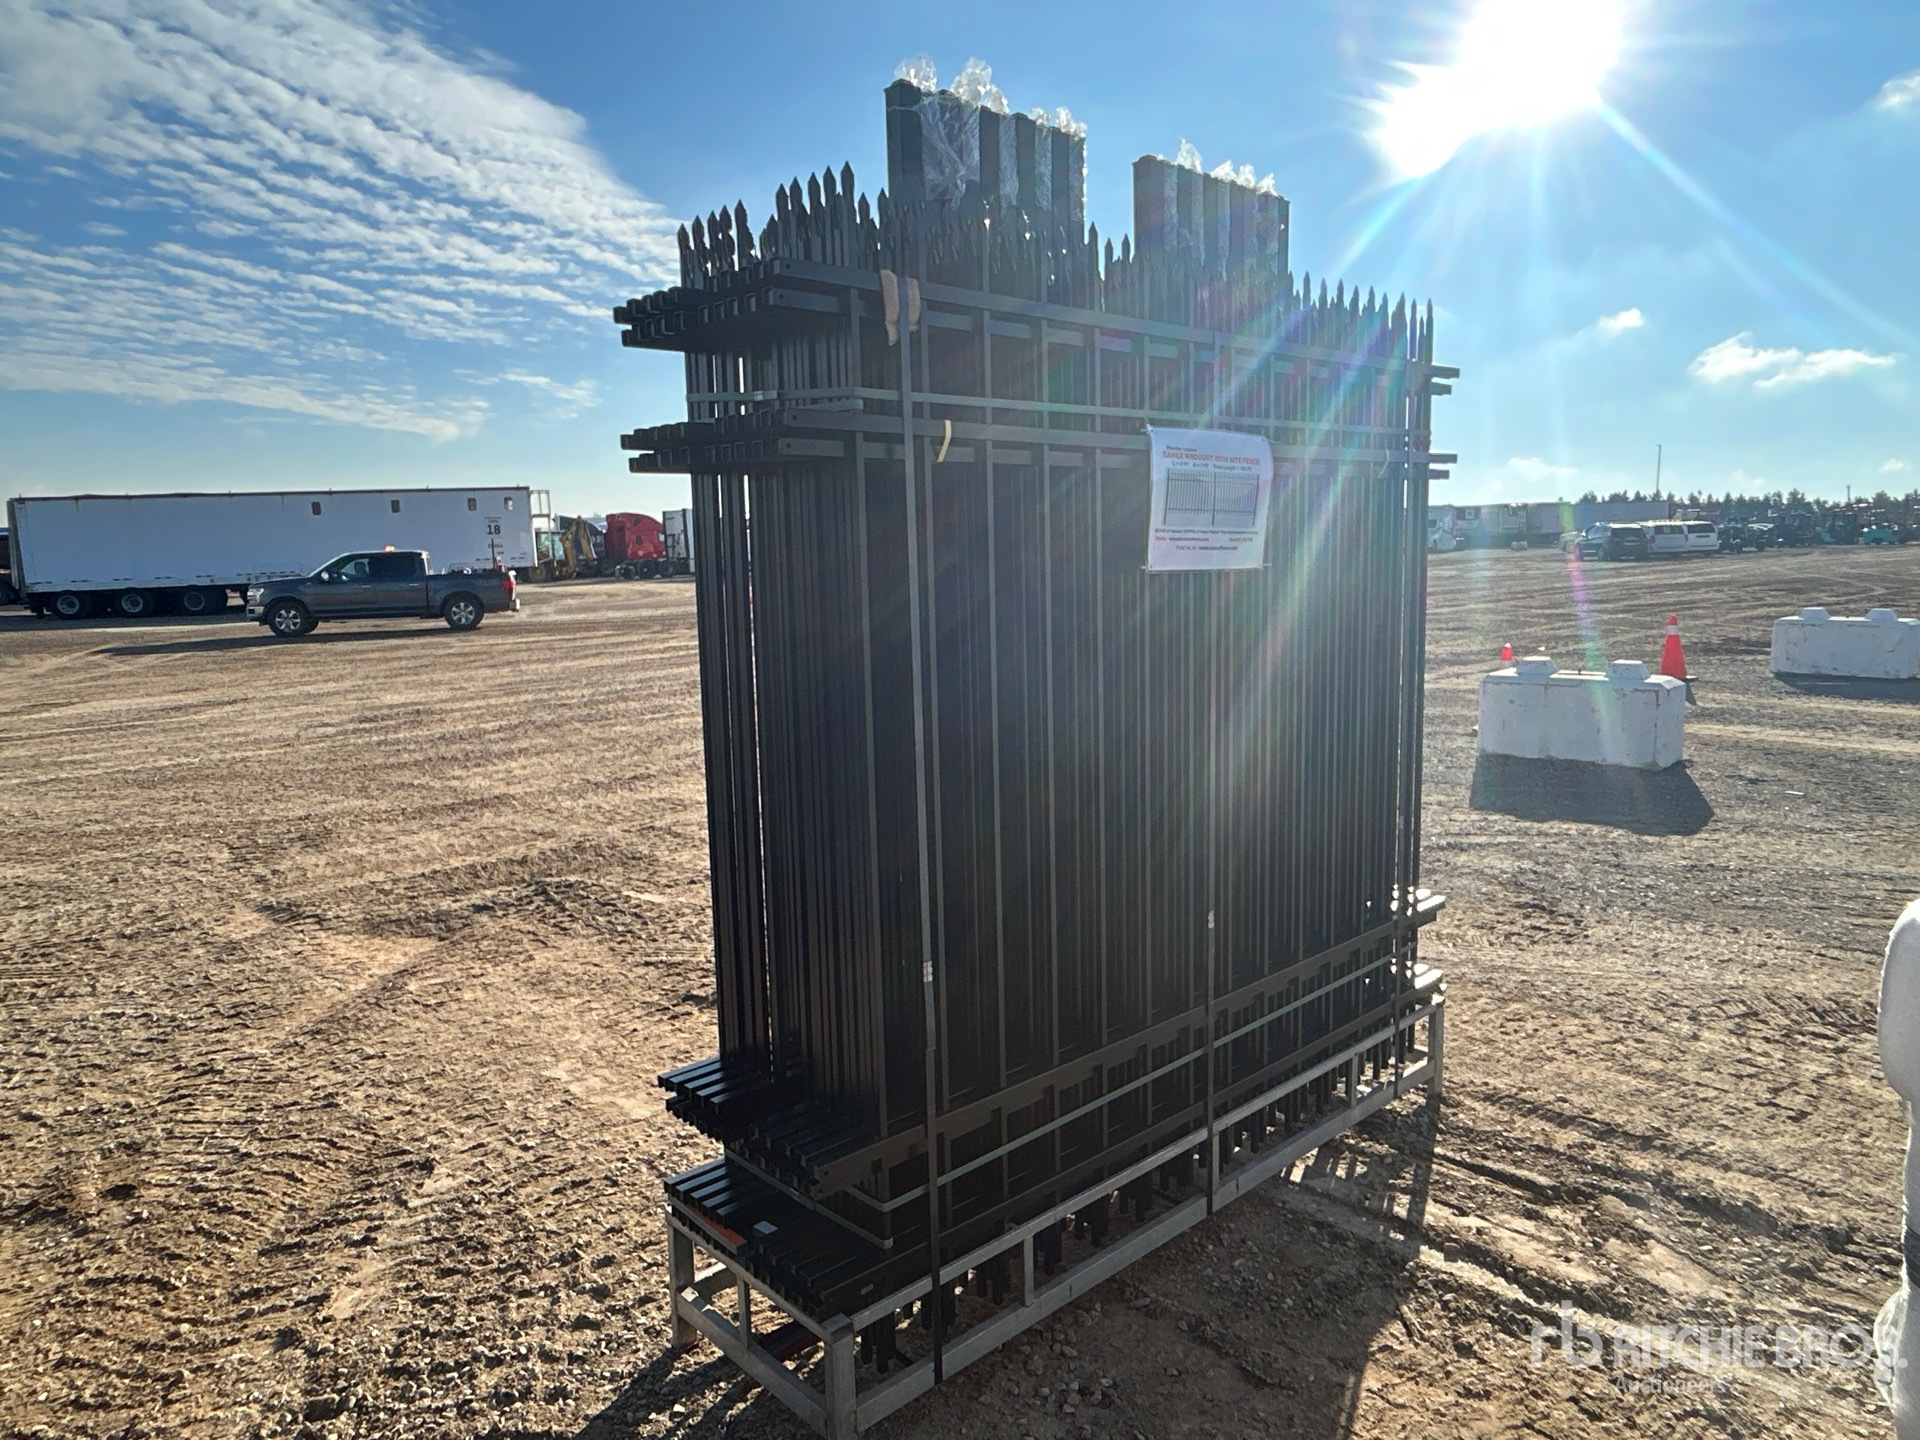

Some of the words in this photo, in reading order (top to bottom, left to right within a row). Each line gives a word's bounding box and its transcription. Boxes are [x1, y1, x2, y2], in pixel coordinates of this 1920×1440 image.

[1184, 453, 1214, 461] WROUGHT
[1229, 456, 1241, 464] SITE
[1242, 457, 1260, 466] FENCE
[487, 524, 501, 535] 18
